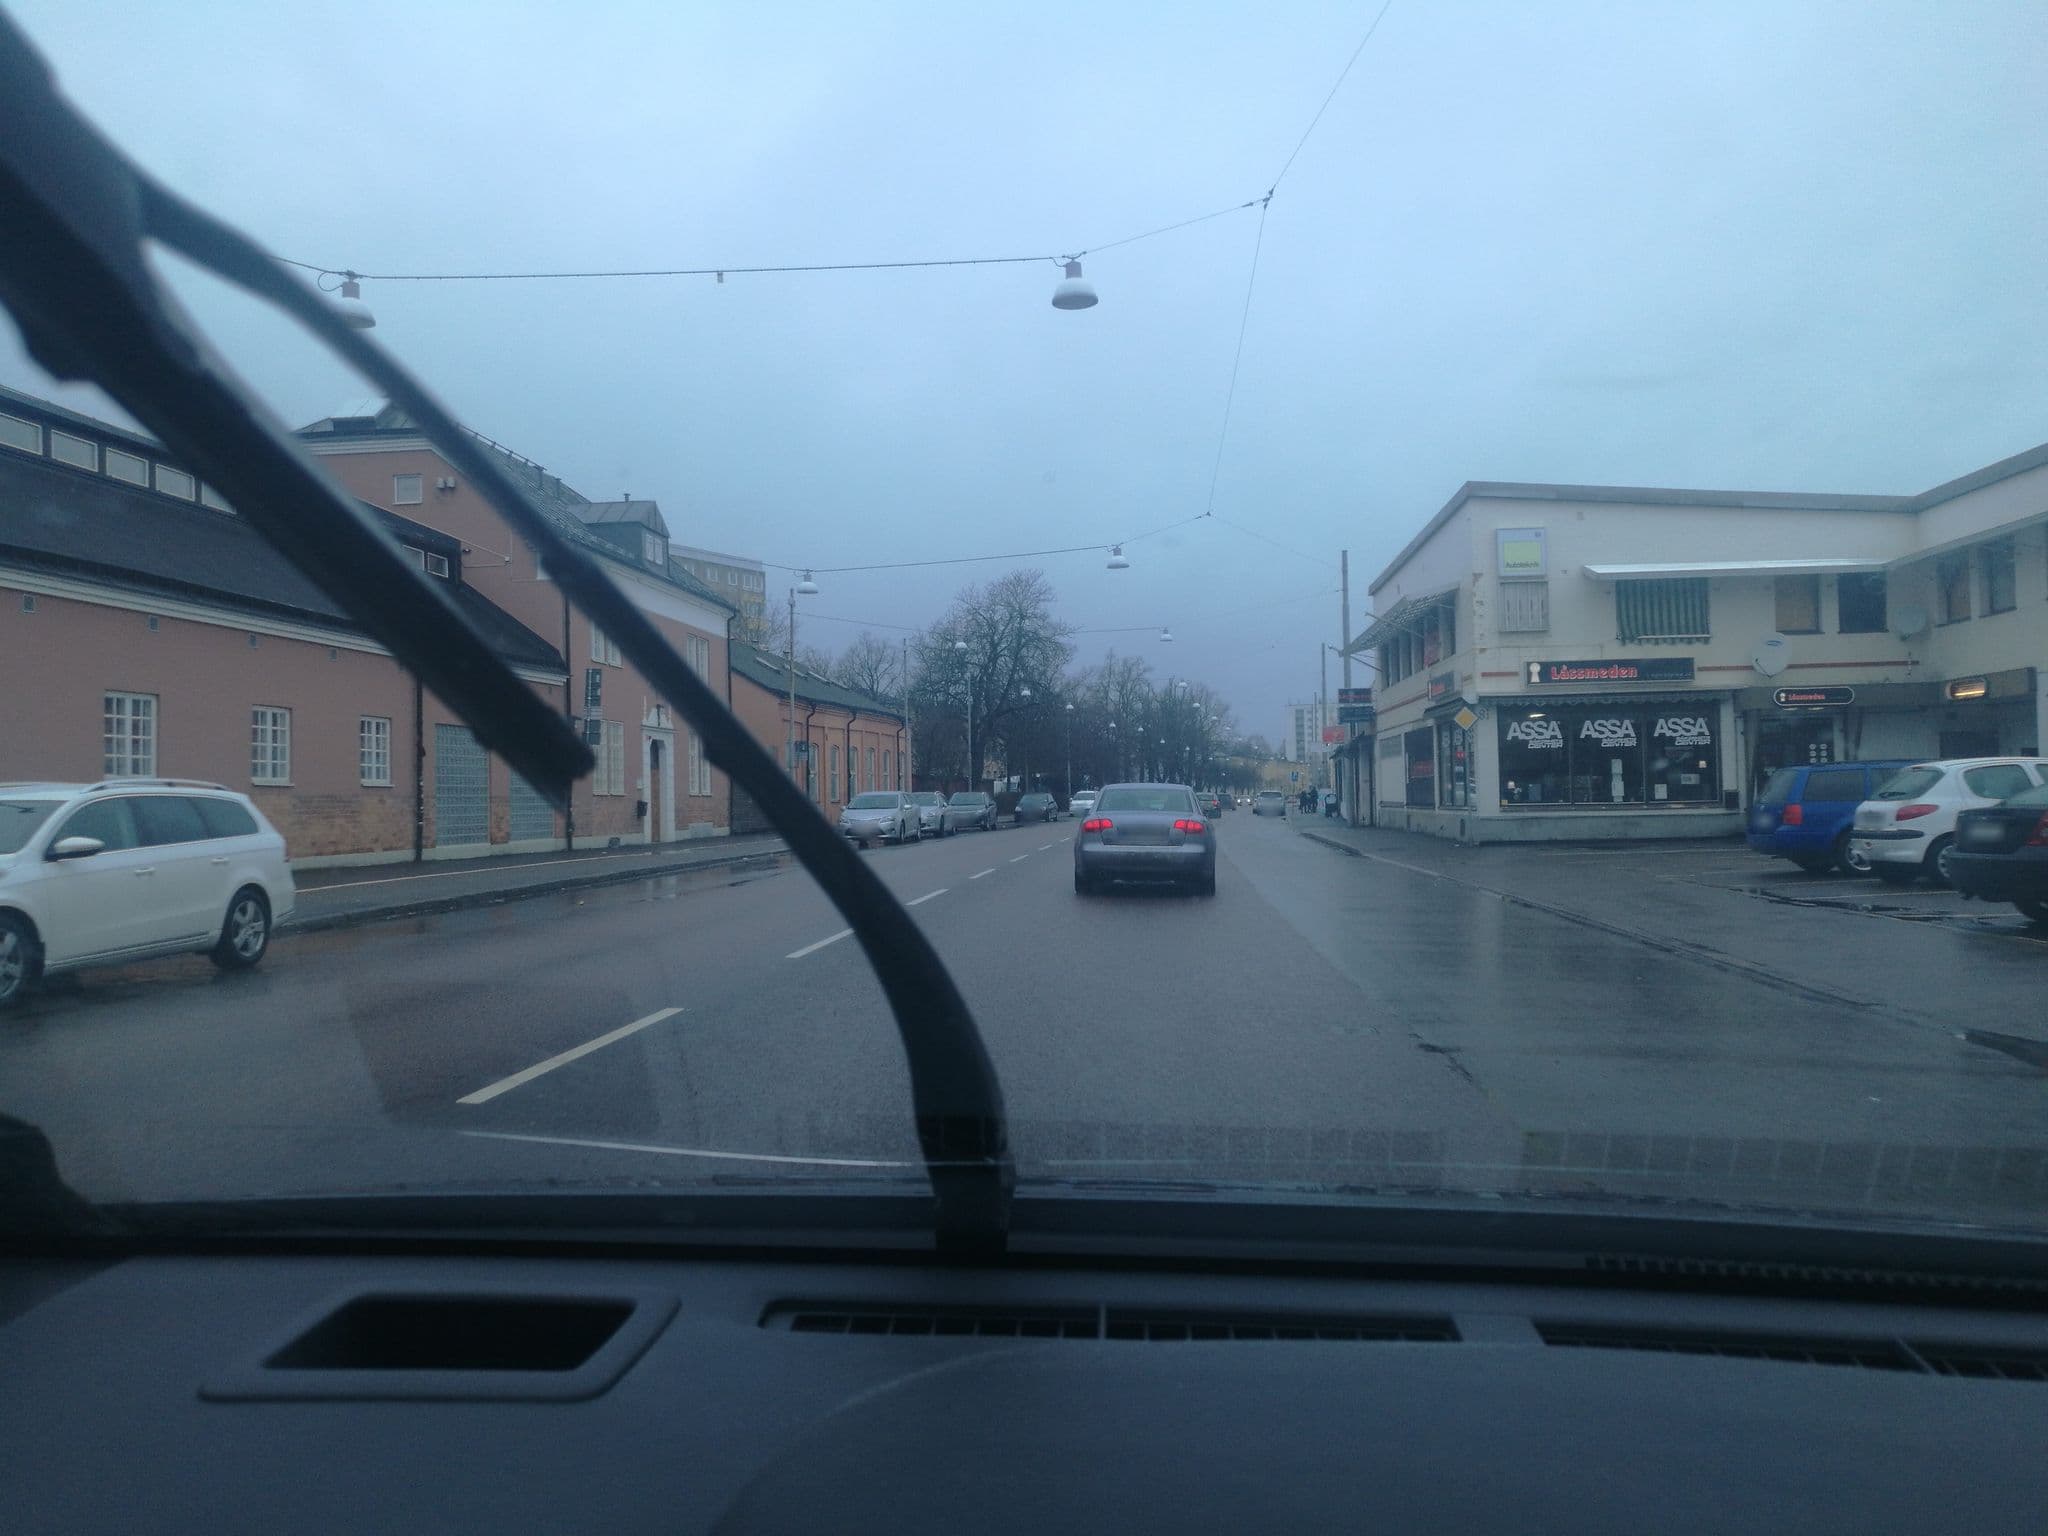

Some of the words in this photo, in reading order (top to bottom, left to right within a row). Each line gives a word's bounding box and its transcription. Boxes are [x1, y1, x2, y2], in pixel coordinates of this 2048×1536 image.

[1551, 664, 1638, 680] Låssmeden
[1507, 720, 1562, 740] ASSA
[1580, 719, 1636, 738] ASSA
[1654, 717, 1710, 736] ASSA
